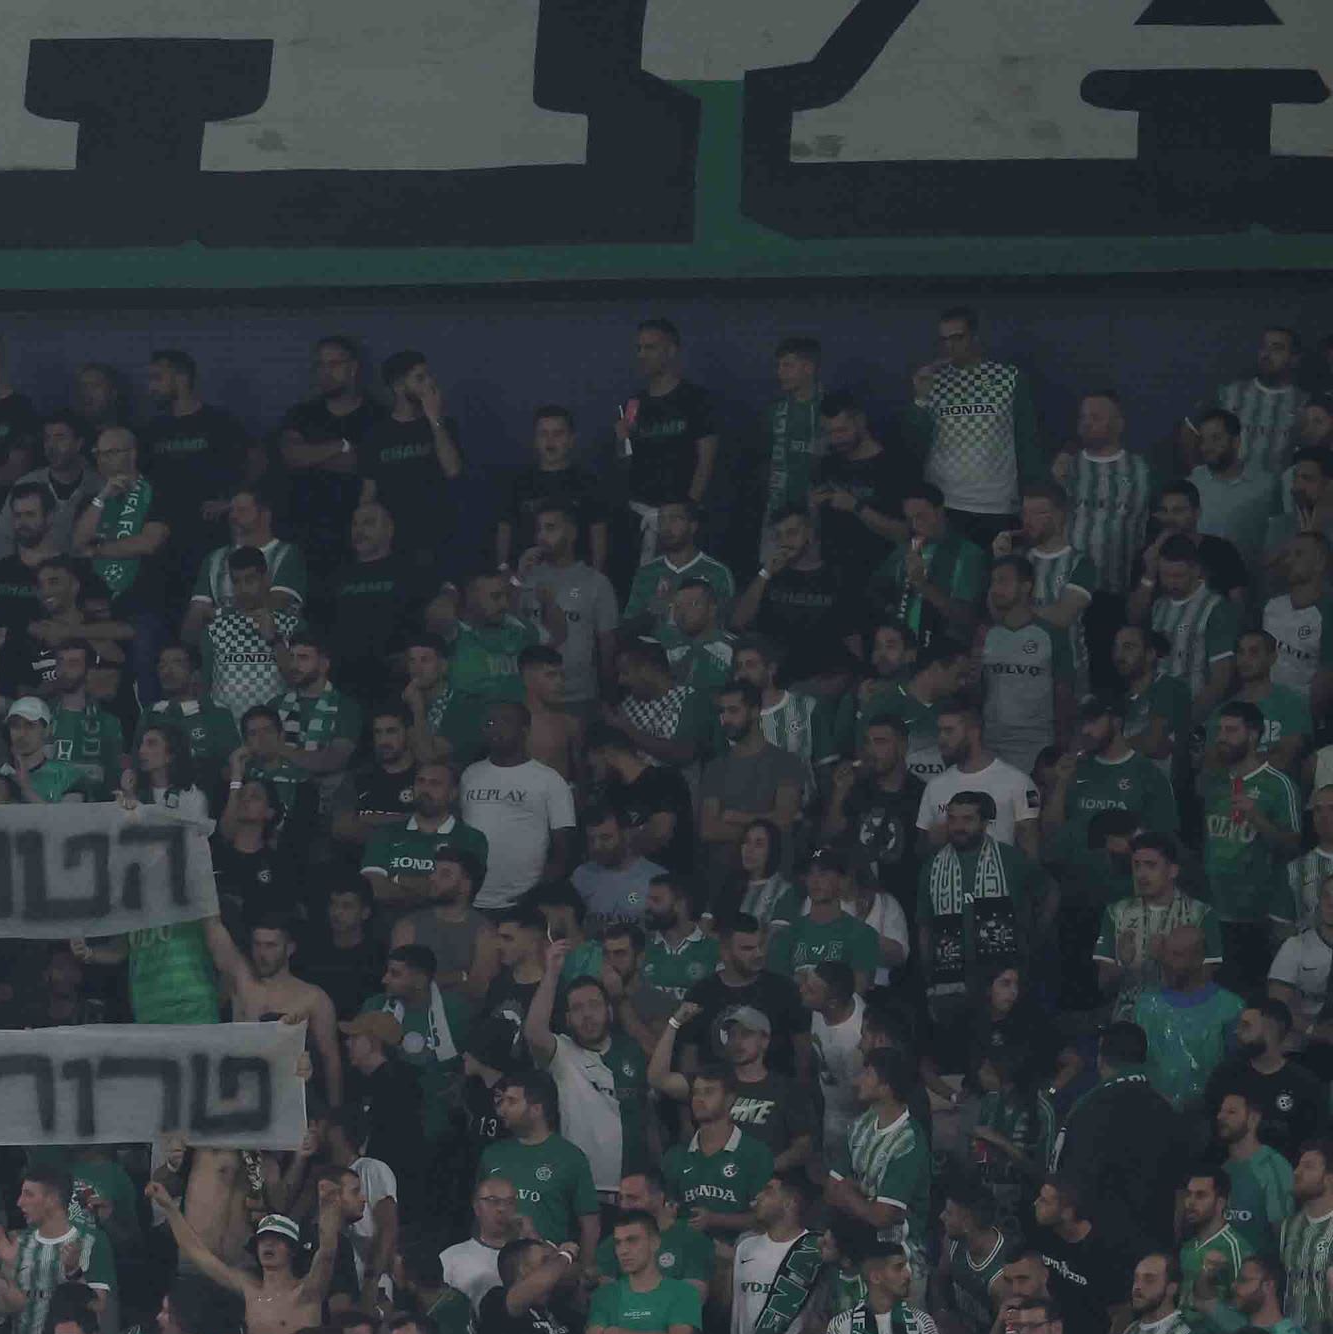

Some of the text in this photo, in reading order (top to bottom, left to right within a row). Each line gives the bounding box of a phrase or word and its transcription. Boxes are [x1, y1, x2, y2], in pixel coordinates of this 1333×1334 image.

[939, 404, 997, 418] HONDA
[223, 653, 278, 665] HONDA
[464, 788, 529, 803] REPLAY
[389, 855, 435, 871] HOND
